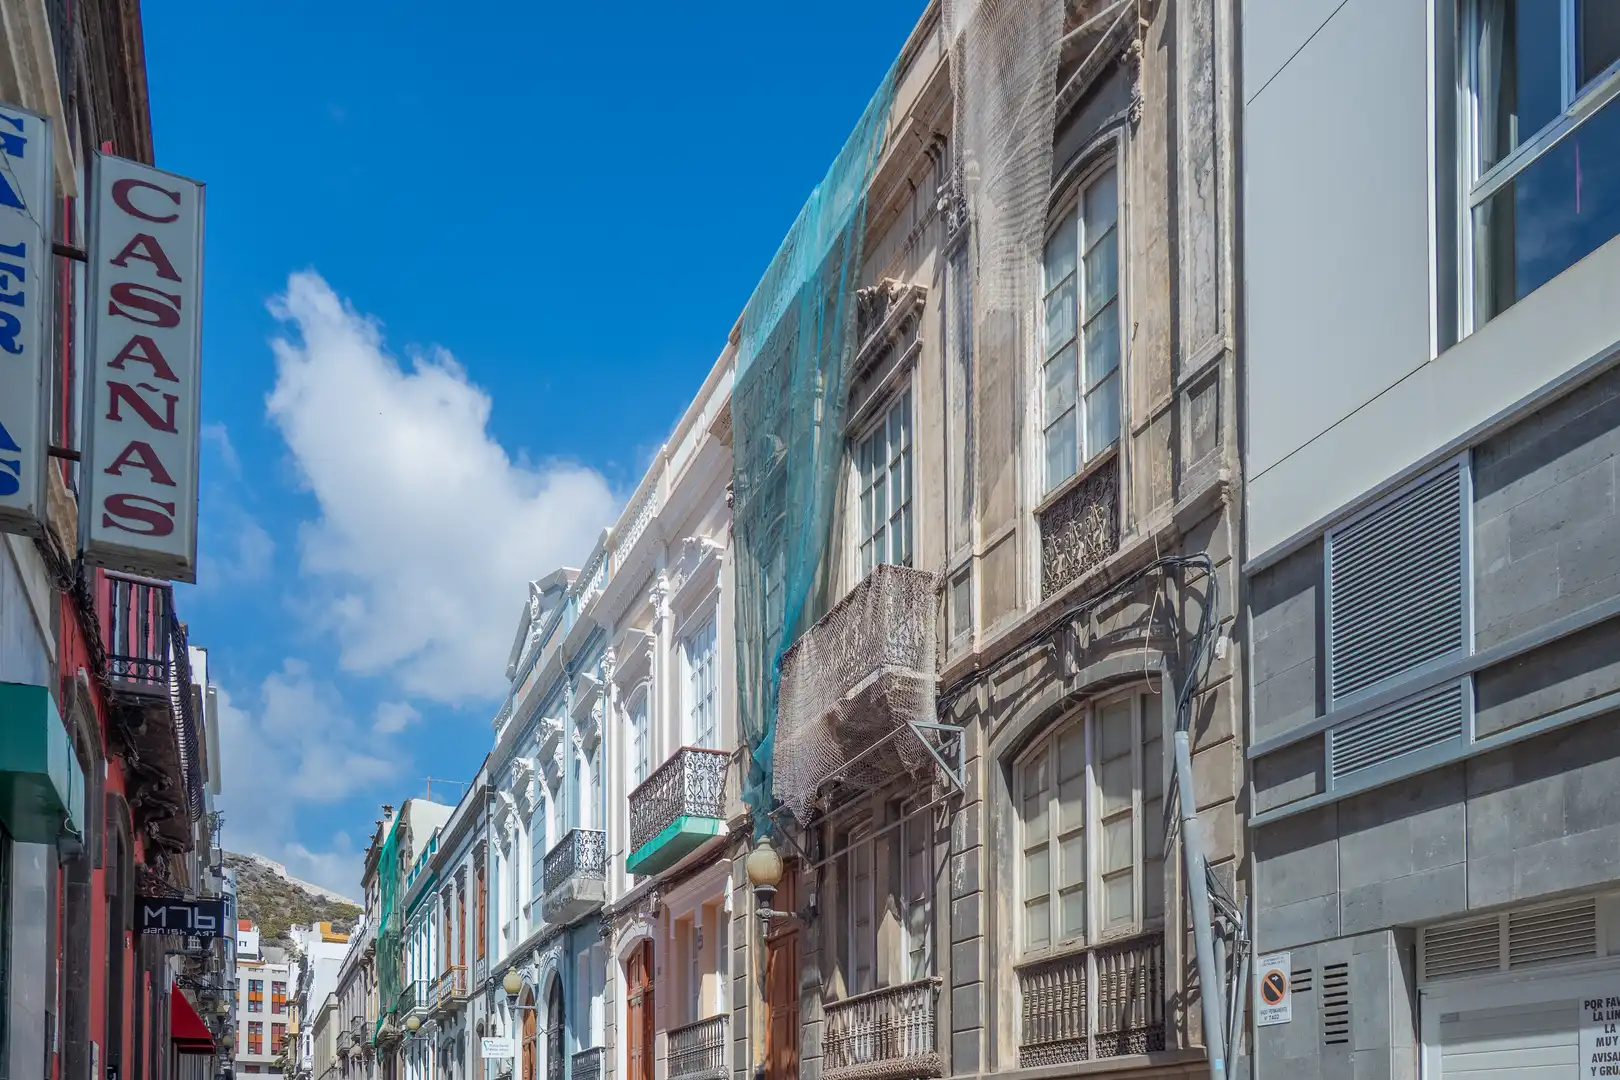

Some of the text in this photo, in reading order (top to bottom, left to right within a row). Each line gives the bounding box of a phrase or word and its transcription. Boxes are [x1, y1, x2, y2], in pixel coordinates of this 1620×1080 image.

[102, 178, 182, 537] CASAÑAS
[1584, 998, 1603, 1010] POR
[1593, 1011, 1603, 1022] LA
[1605, 1023, 1616, 1034] LA
[1596, 1036, 1619, 1047] MUY
[1591, 1052, 1620, 1063] AVISA
[1591, 1062, 1620, 1076] Y GRÚ
